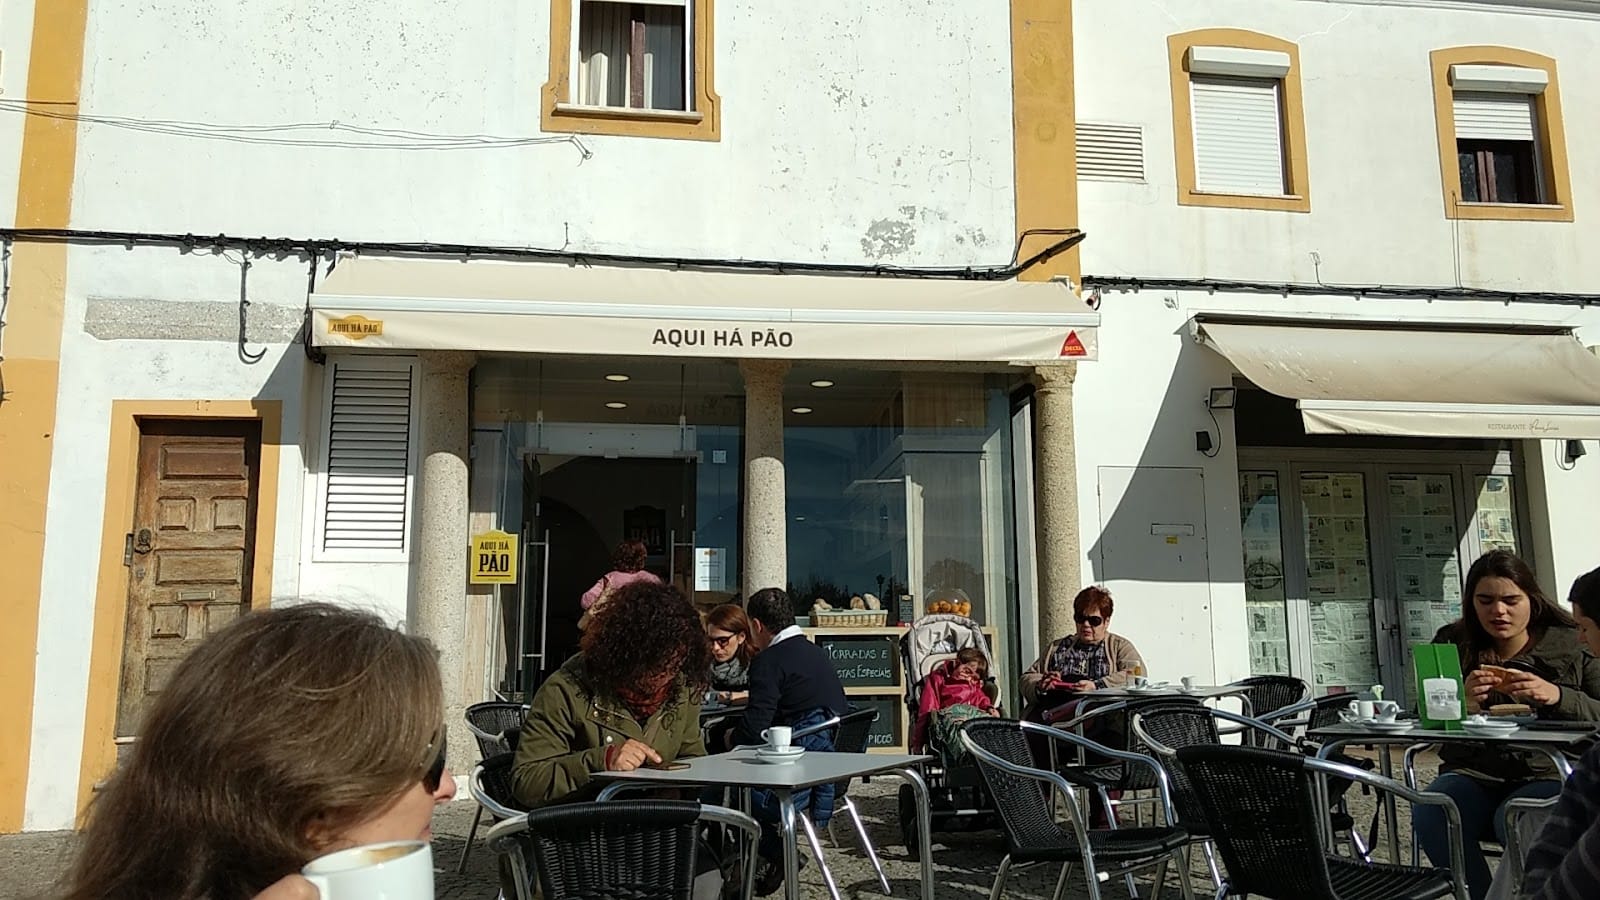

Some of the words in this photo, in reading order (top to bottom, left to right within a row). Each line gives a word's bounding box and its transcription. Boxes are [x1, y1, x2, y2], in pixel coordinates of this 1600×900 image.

[332, 323, 349, 333] AQUI
[652, 328, 705, 348] AQUI
[714, 327, 744, 347] HÁ
[751, 327, 793, 347] PÃO
[480, 541, 496, 550] AQUI
[498, 540, 509, 550] HÁ
[479, 551, 509, 572] PÃO
[881, 650, 888, 659] E
[836, 669, 856, 679] STAS
[868, 734, 893, 744] PICOS
